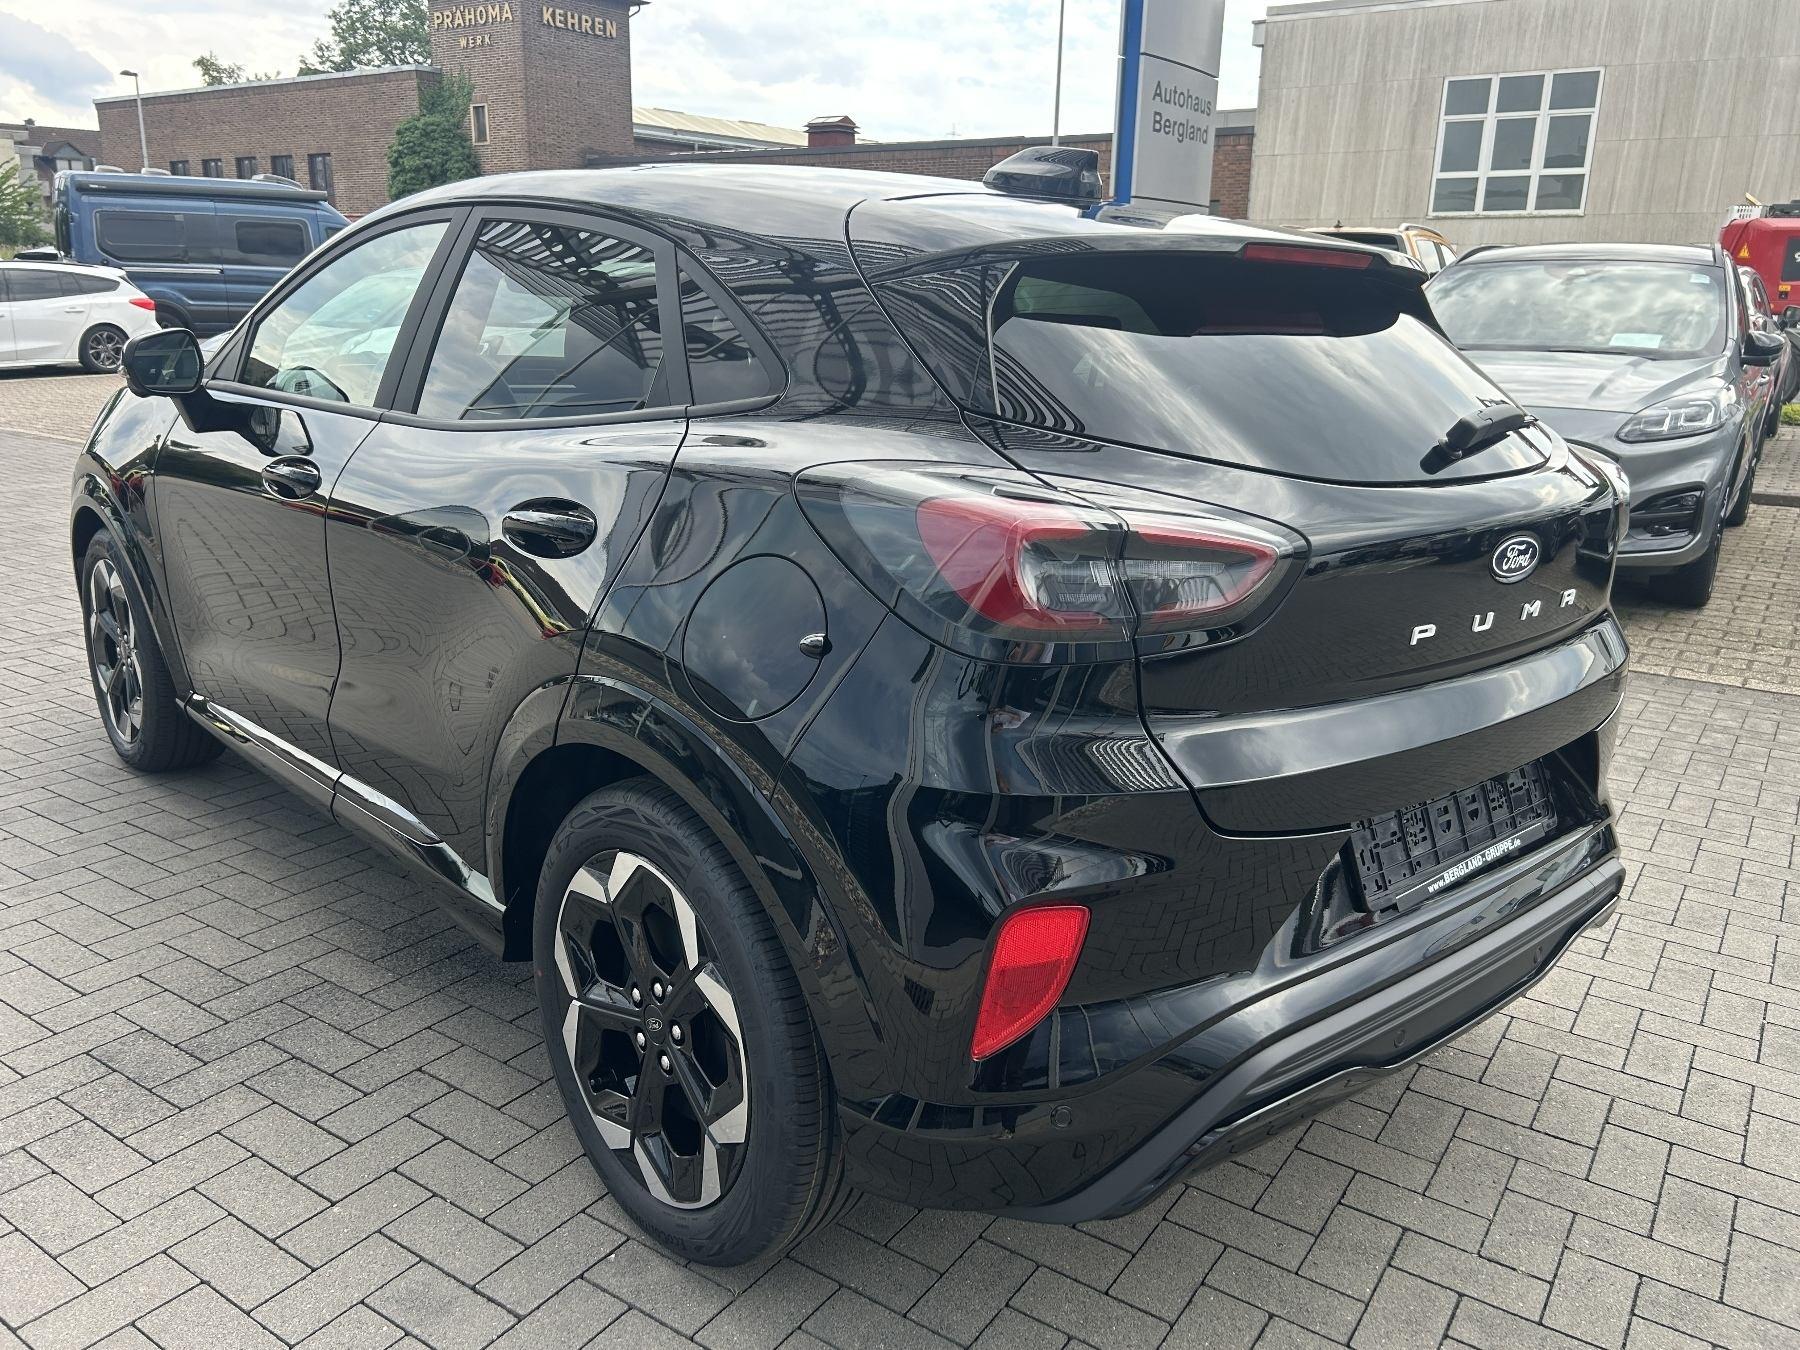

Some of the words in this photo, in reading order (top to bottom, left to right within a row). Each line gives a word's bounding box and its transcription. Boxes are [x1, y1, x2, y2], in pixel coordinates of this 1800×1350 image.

[434, 4, 513, 30] PRÄHOMA
[542, 6, 617, 39] KEHREN
[460, 34, 491, 49] WERK
[1152, 80, 1212, 116] Autohaus
[1152, 111, 1209, 144] Bergland
[1502, 544, 1533, 570] Ford
[1428, 838, 1521, 893] www.BERGLAND-GRUPPE.de
